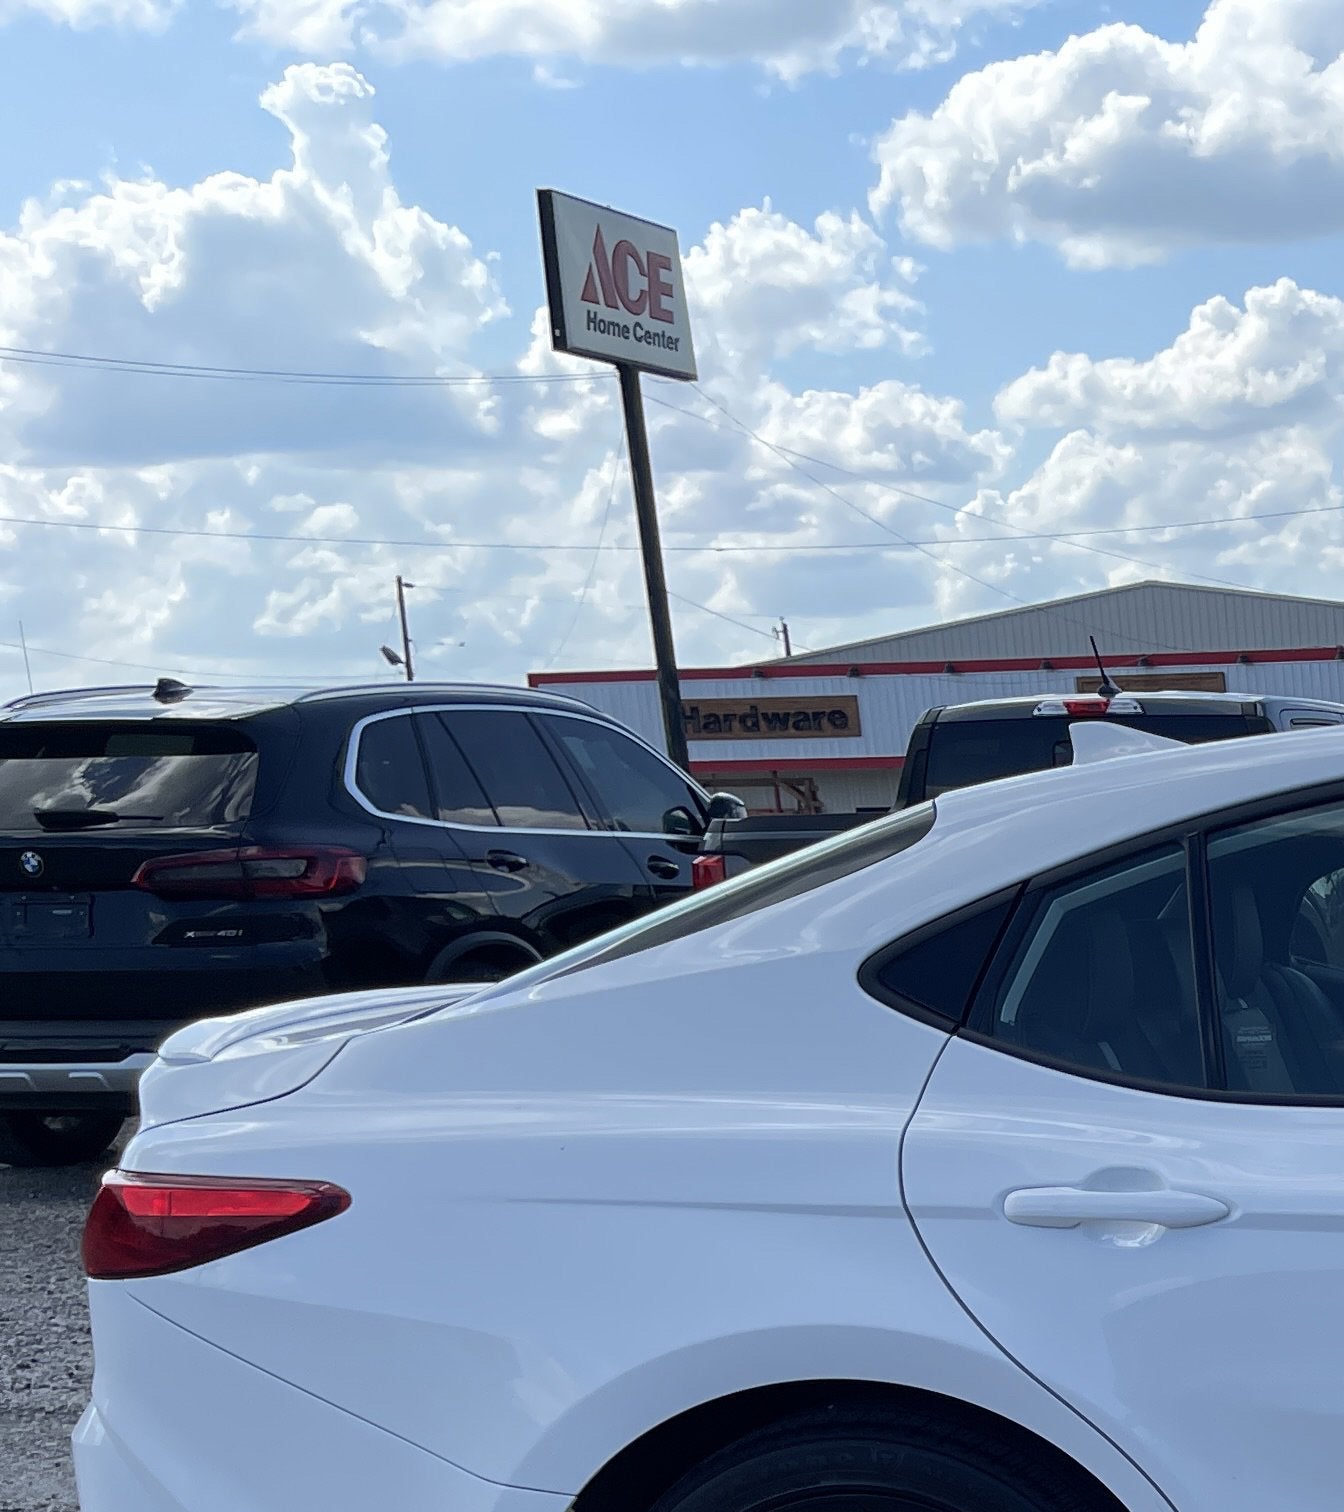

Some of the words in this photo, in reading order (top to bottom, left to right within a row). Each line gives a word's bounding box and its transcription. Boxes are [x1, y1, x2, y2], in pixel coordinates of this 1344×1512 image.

[580, 223, 675, 324] ACE
[586, 309, 630, 340] Home
[632, 321, 680, 351] Center
[682, 705, 849, 734] Hardware
